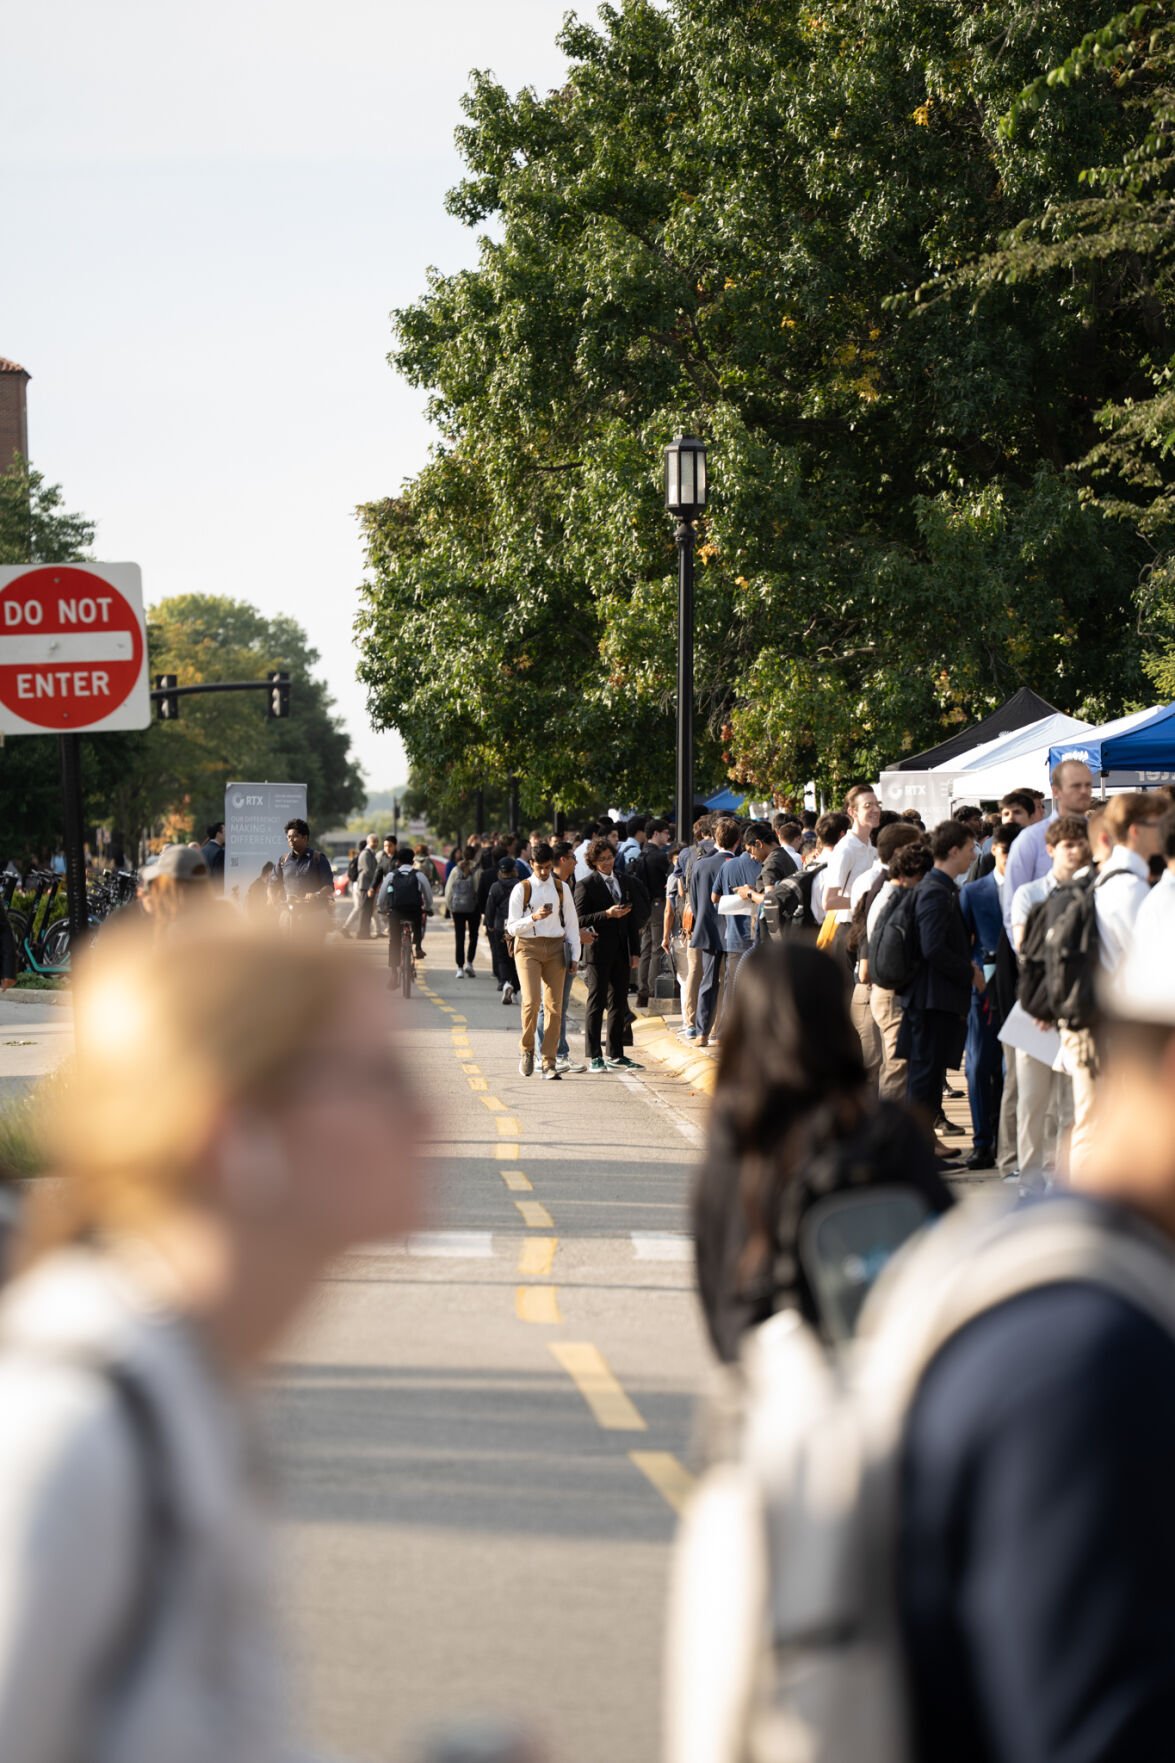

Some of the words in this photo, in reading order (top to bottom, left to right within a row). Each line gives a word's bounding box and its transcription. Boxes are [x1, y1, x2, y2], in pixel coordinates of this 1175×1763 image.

[4, 600, 43, 626] DO
[58, 597, 113, 624] NOT
[17, 671, 110, 699] ENTER
[246, 796, 263, 806] RTX
[231, 824, 265, 833] MAKING
[231, 834, 284, 845] DIFFERENCE
